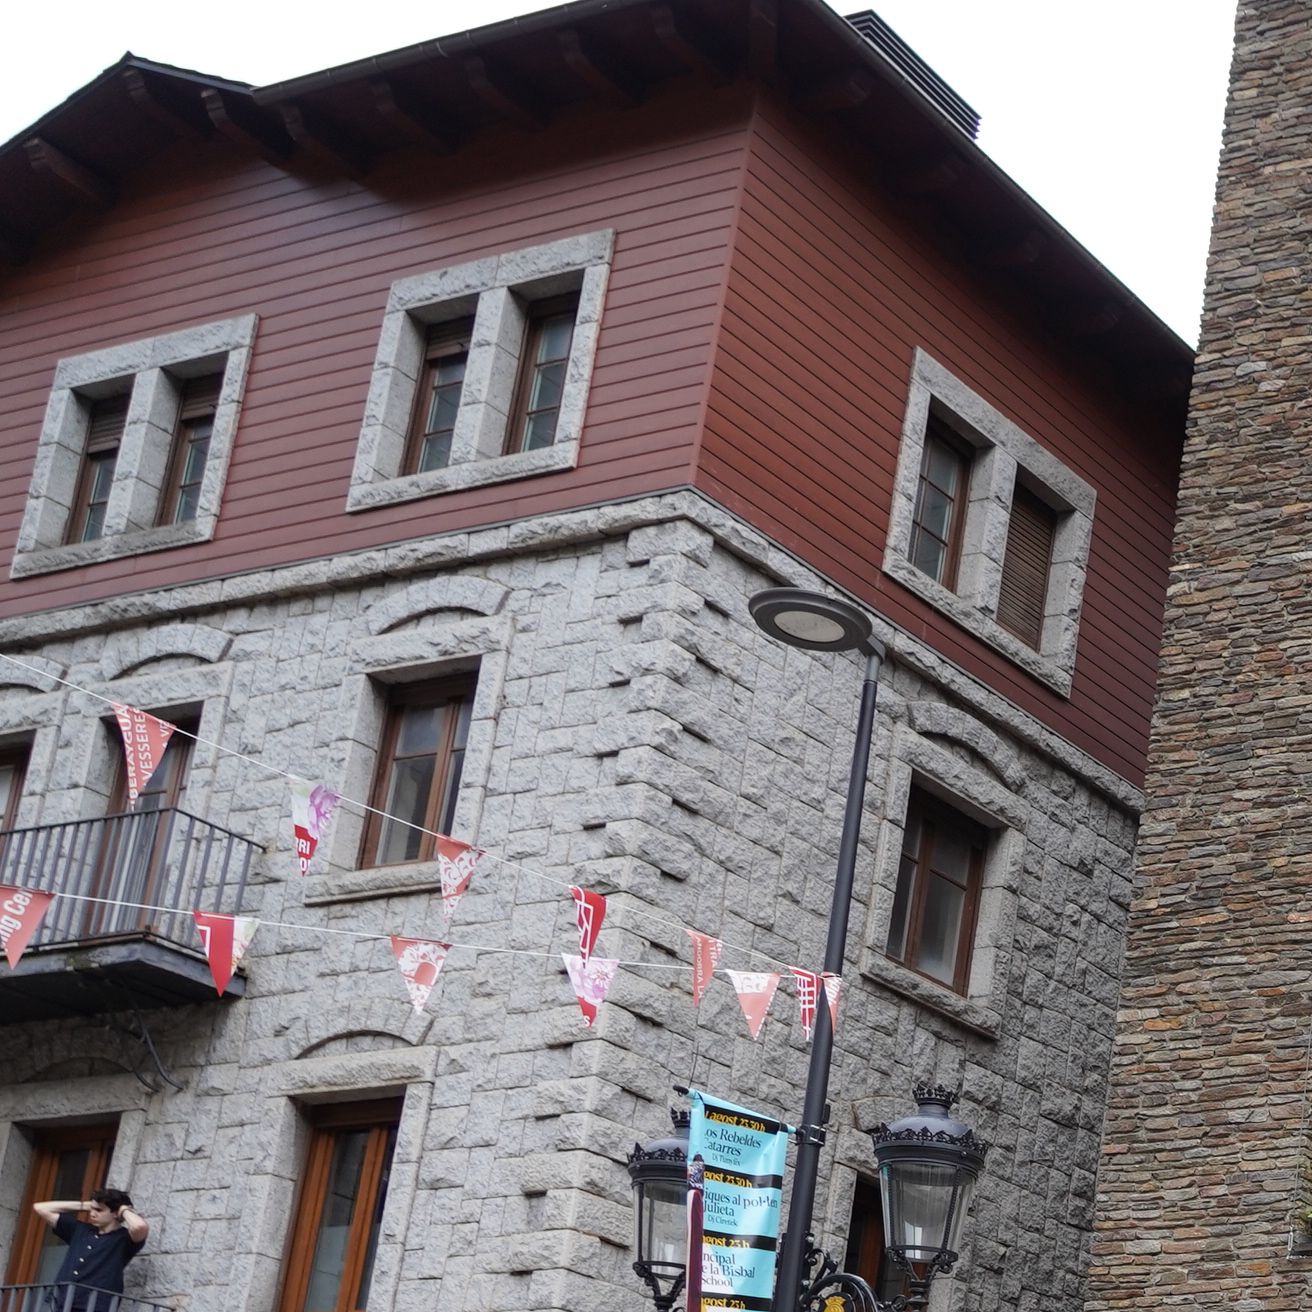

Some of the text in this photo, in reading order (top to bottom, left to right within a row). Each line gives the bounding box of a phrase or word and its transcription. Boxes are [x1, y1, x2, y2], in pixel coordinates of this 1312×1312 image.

[704, 1128, 761, 1149] os Rebeldes
[704, 1140, 742, 1157] atarres
[704, 1170, 724, 1182] gost
[732, 1194, 741, 1206] al
[703, 1252, 735, 1266] ncipal
[711, 1263, 719, 1275] la
[722, 1264, 755, 1279] Bisbal
